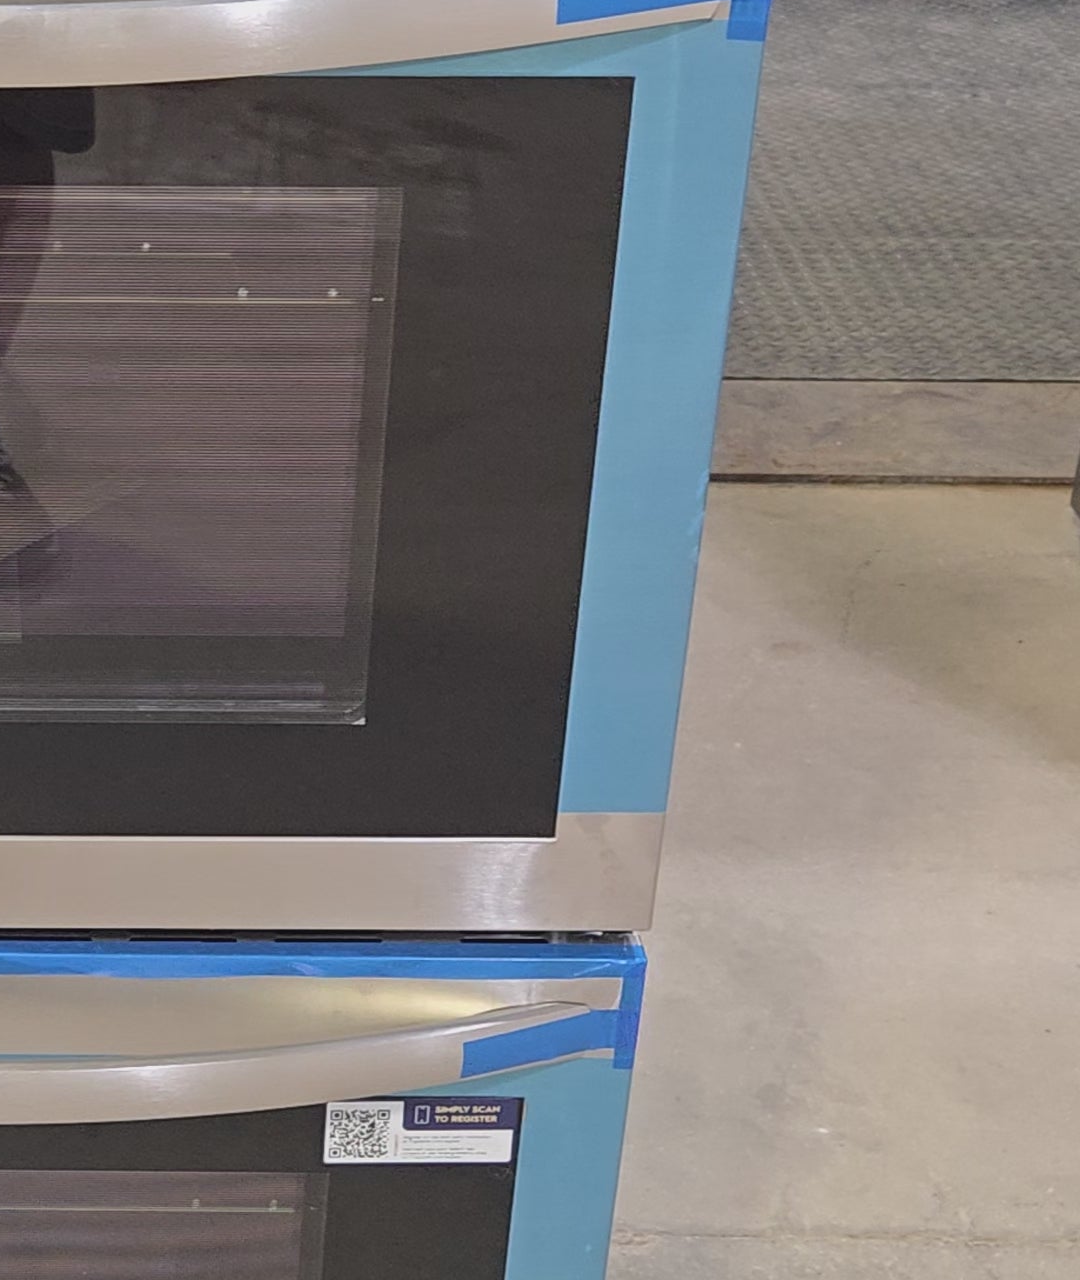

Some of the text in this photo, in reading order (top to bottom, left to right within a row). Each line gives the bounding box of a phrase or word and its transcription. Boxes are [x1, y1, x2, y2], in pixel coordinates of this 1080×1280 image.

[434, 1105, 501, 1114] SIMPLY SCAN
[434, 1115, 498, 1123] TO REGISTER
